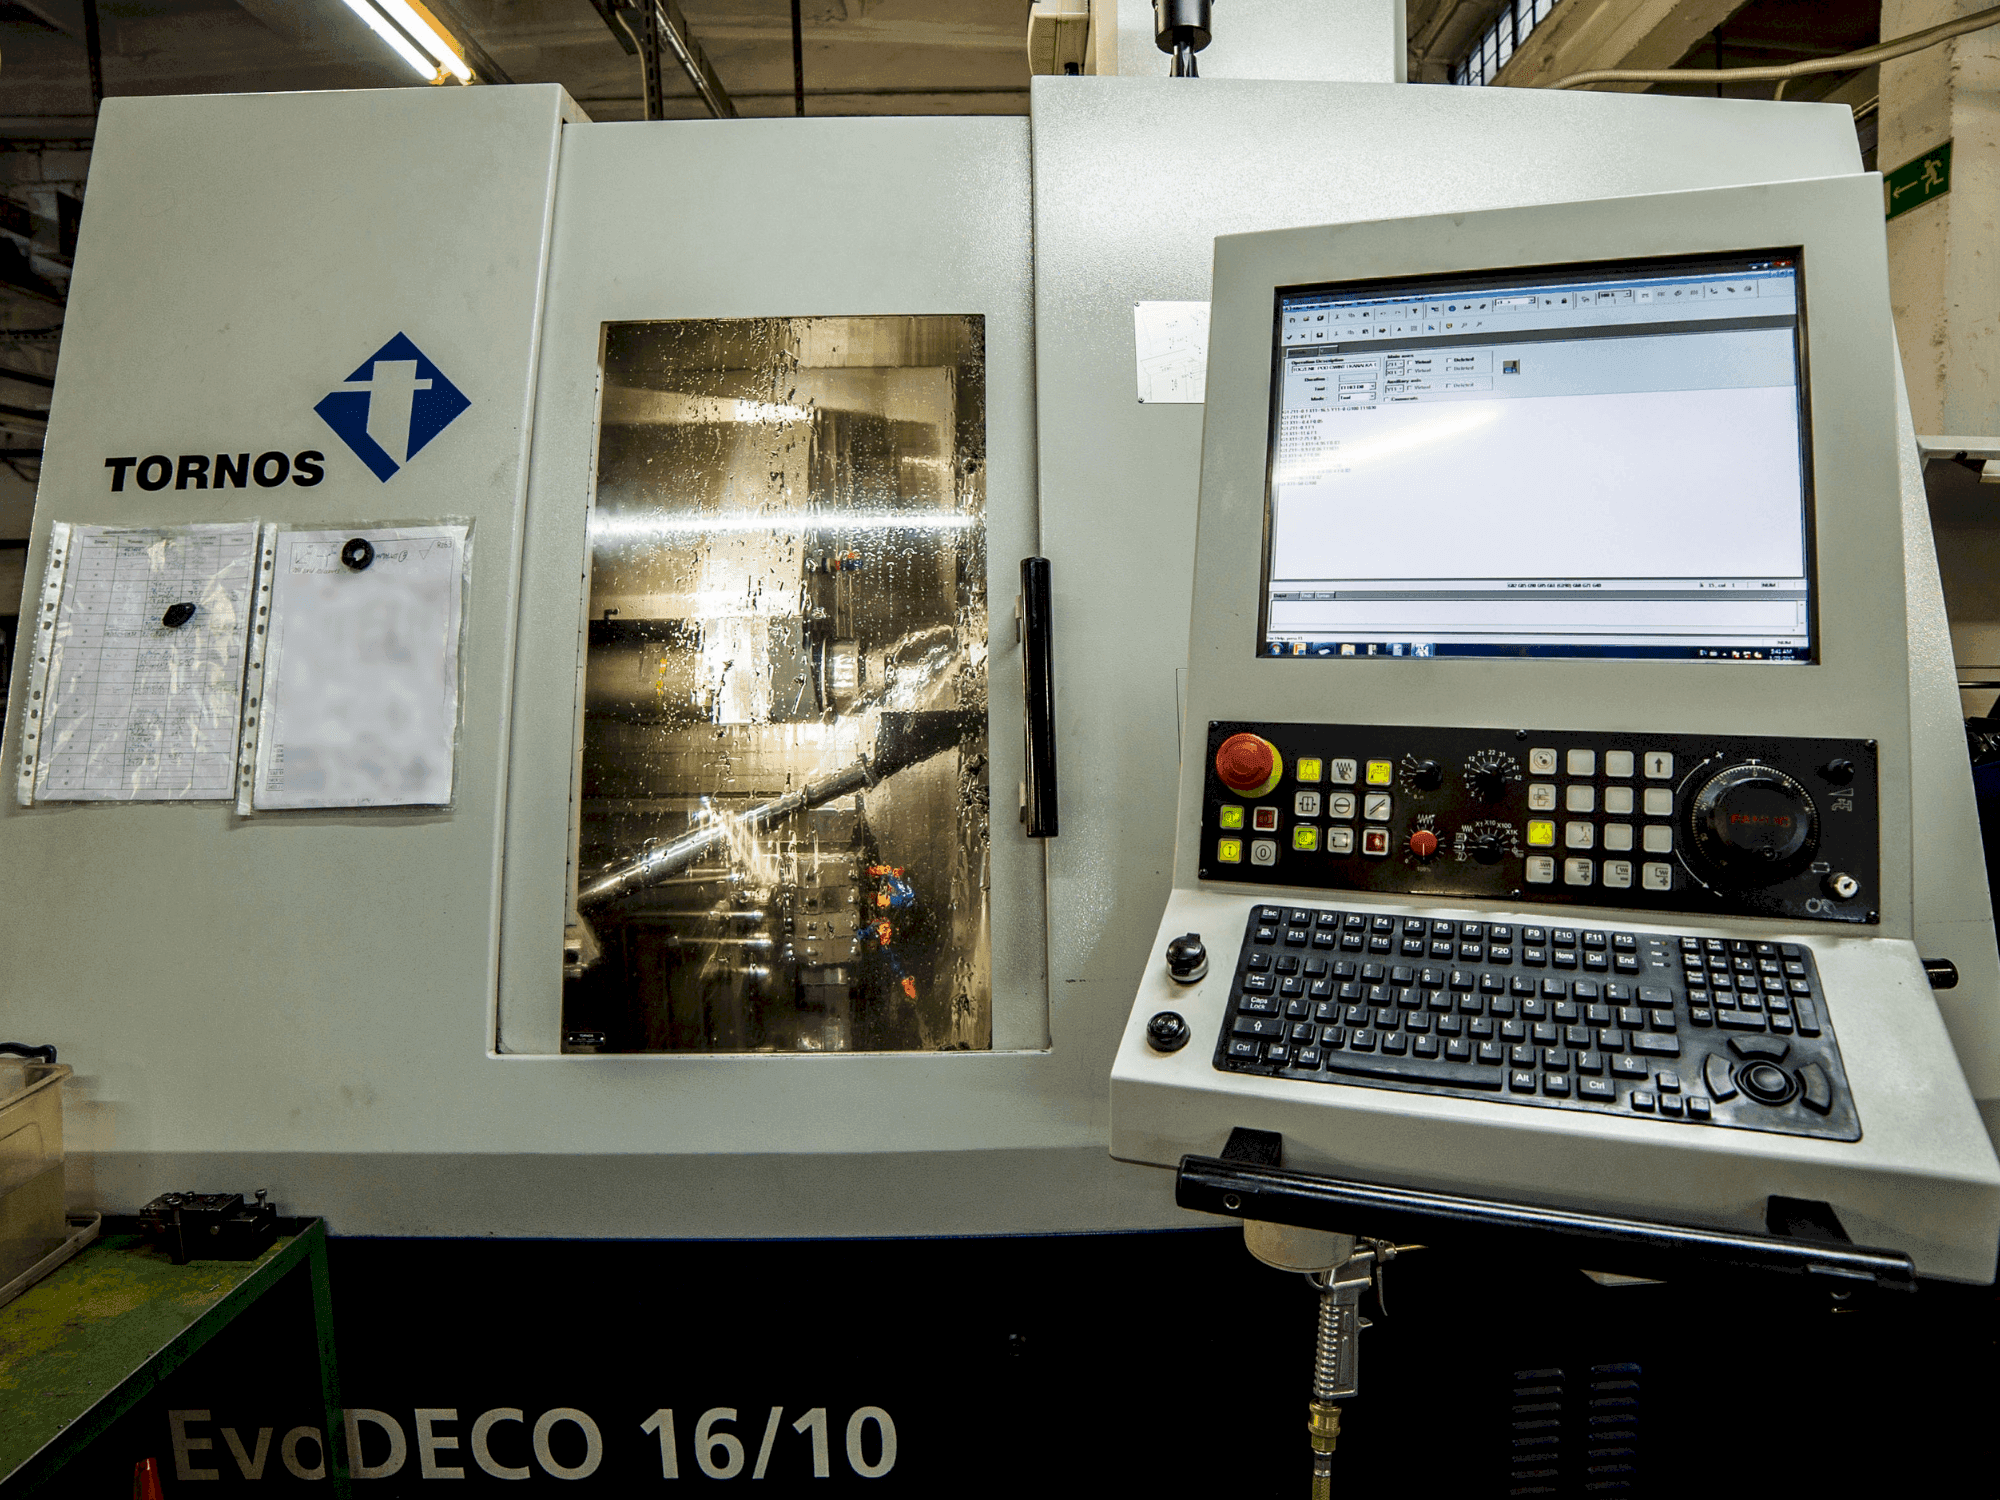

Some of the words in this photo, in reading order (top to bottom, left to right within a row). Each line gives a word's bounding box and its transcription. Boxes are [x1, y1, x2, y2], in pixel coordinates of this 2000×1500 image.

[104, 450, 325, 492] TORNOS
[1262, 909, 1277, 917] Esc
[1321, 914, 1333, 922] F2
[1288, 931, 1304, 939] F13
[1316, 933, 1331, 941] F14
[1528, 929, 1540, 937] F9
[1555, 931, 1572, 939] F10
[1586, 933, 1602, 941] F11
[1344, 935, 1359, 943] F15
[1616, 935, 1633, 943] F12
[1404, 940, 1420, 948] F17
[1492, 947, 1509, 955] F20
[1556, 951, 1574, 960] Home
[1589, 954, 1602, 962] Del
[1619, 957, 1635, 965] End
[1343, 983, 1350, 991] E
[1402, 988, 1409, 996] T
[1441, 1015, 1449, 1023] H
[1473, 1018, 1479, 1026] J
[1504, 1021, 1512, 1029] K
[1356, 1030, 1365, 1038] C
[1388, 1033, 1396, 1041] V
[1419, 1036, 1426, 1044] B
[1236, 1043, 1251, 1052] Ctrl
[1482, 1043, 1492, 1051] M
[1302, 1051, 1315, 1059] Alt
[1515, 1073, 1530, 1082] Alt
[1589, 1081, 1605, 1089] Ctrl
[168, 1406, 604, 1482] EvoDECO
[639, 1405, 899, 1482] 16/10
